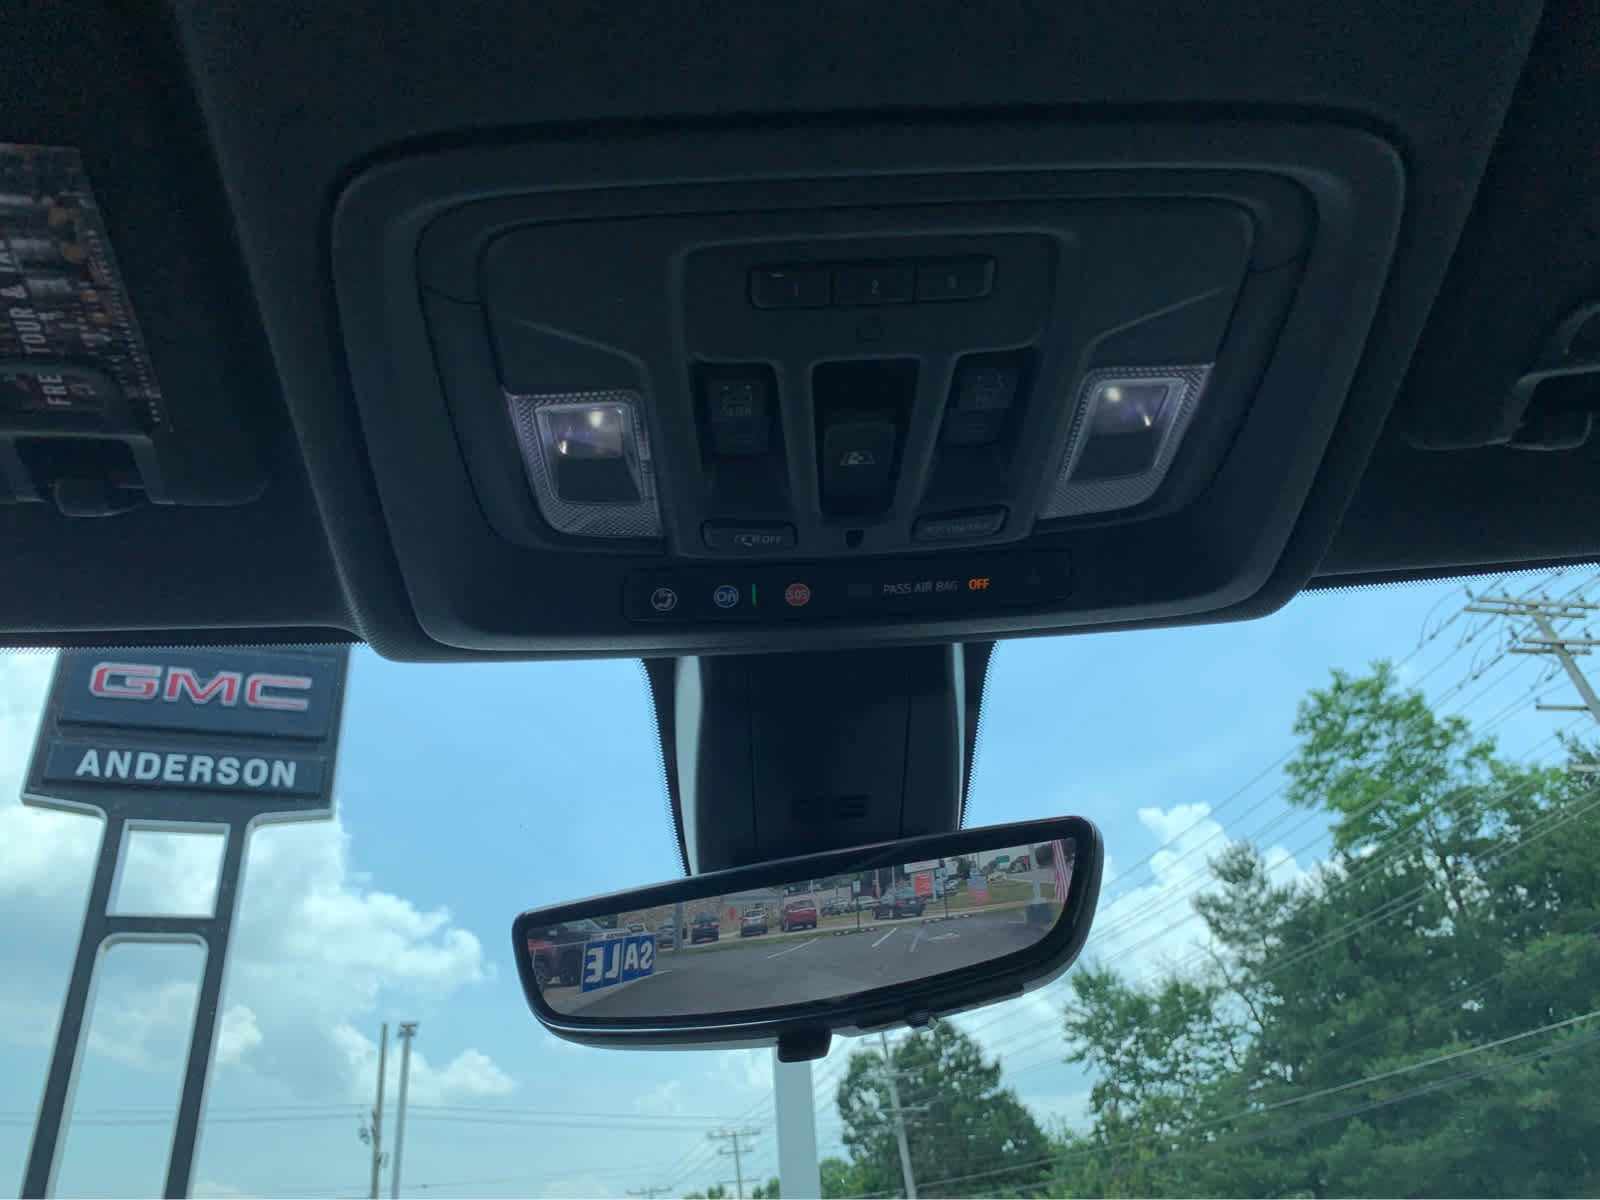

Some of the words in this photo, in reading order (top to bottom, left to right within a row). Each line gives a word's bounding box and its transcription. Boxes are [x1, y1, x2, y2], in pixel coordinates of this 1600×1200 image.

[9, 307, 51, 354] TOUR
[786, 588, 809, 601] SOS
[882, 583, 912, 595] PASS
[914, 581, 932, 593] AIR
[935, 580, 960, 593] BAG
[968, 577, 991, 591] OFF
[89, 662, 313, 711] GMC
[76, 748, 298, 789] ANDERSON
